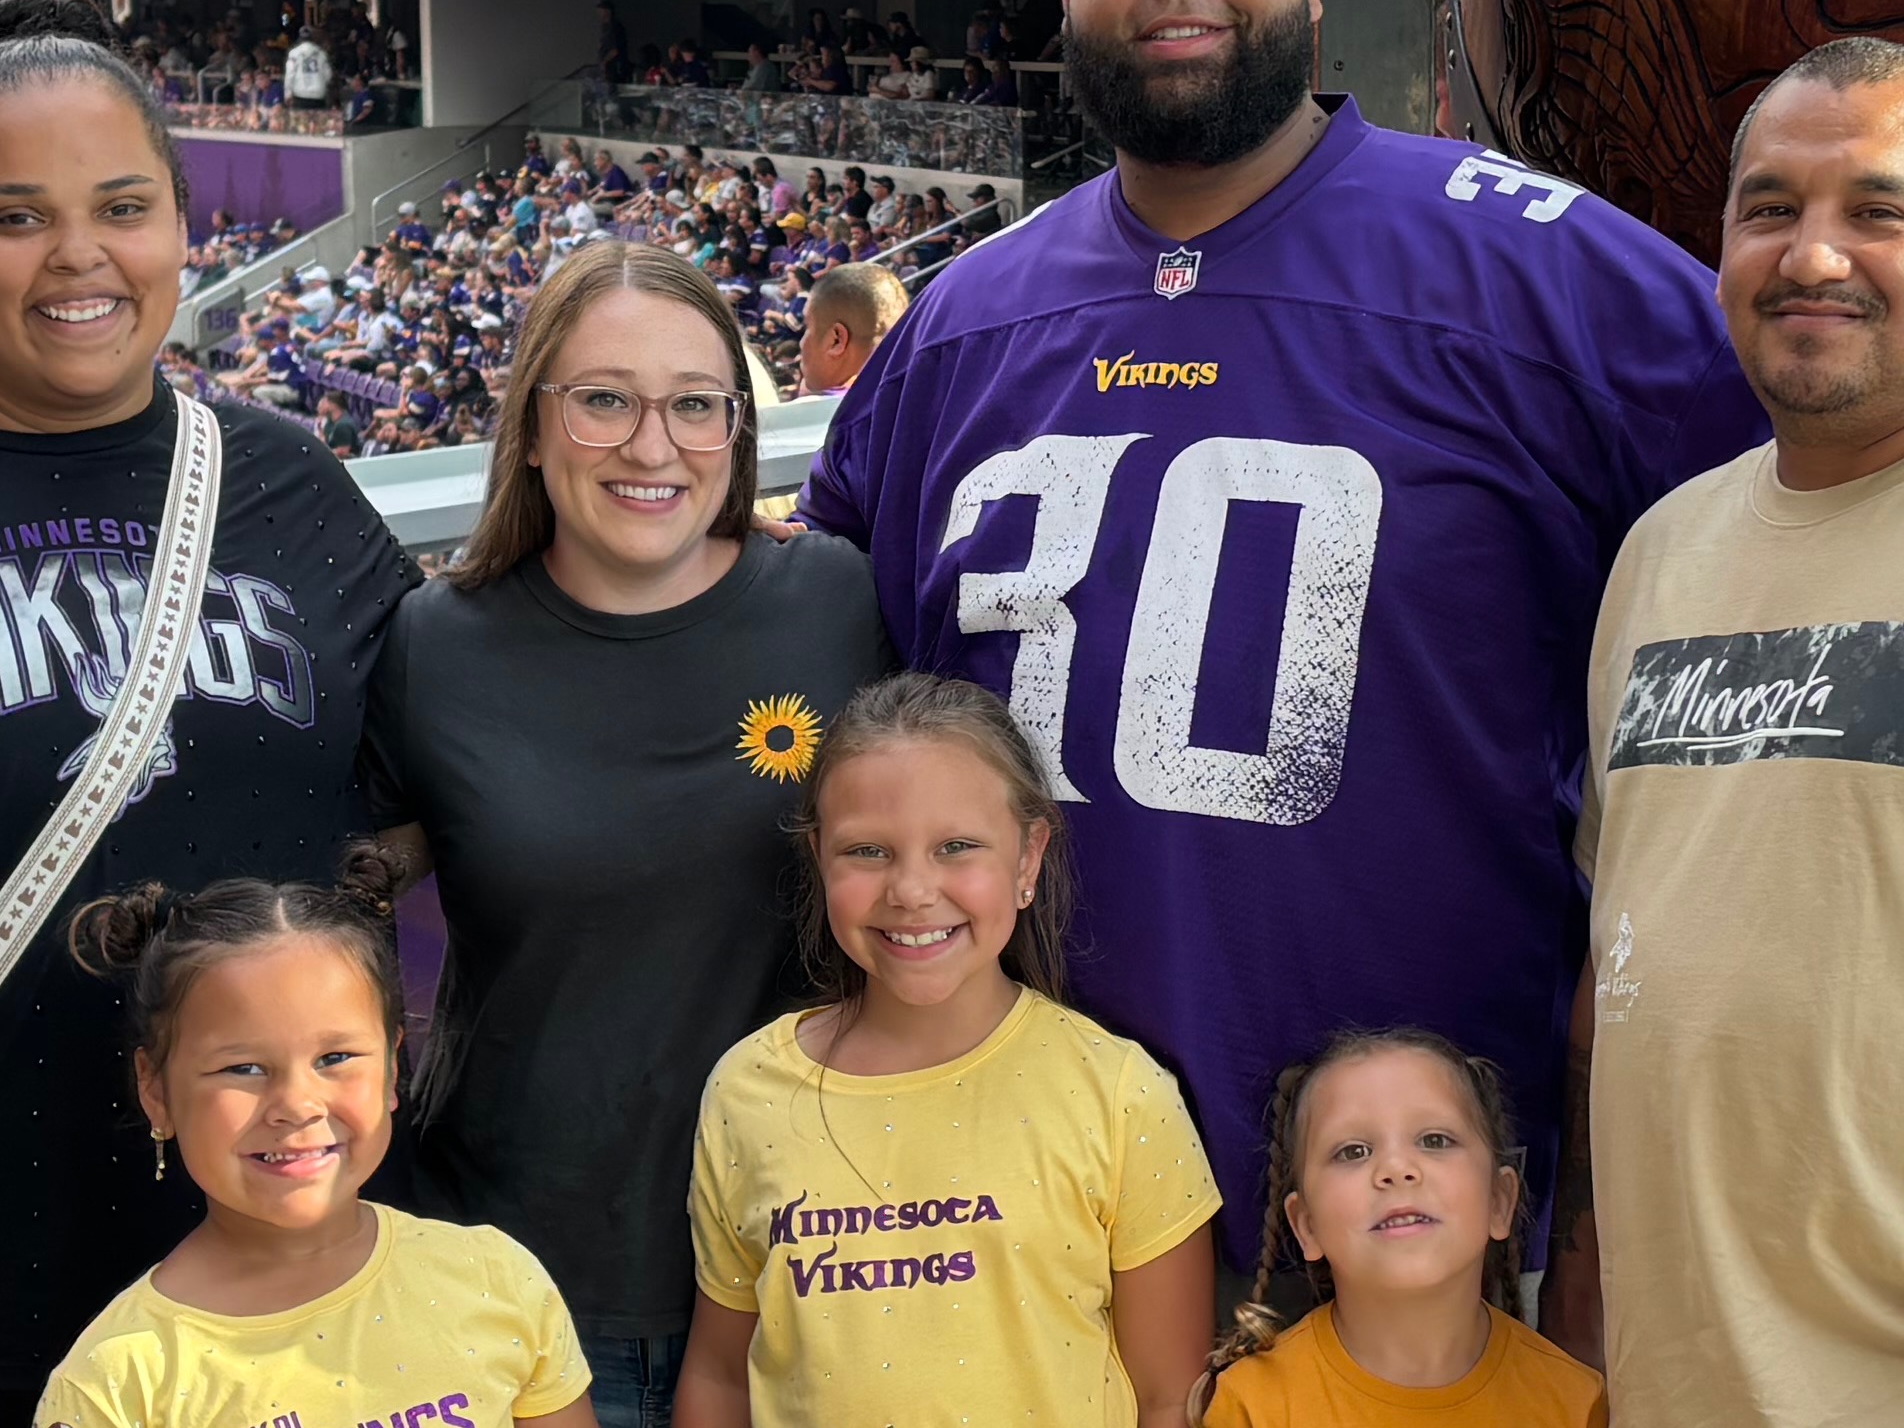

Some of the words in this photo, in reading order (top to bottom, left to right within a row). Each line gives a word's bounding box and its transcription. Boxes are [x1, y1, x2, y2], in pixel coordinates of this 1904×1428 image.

[1158, 266, 1198, 291] NFL
[204, 307, 238, 332] 136
[938, 432, 1383, 827] 30
[1653, 642, 1836, 737] Minnesota
